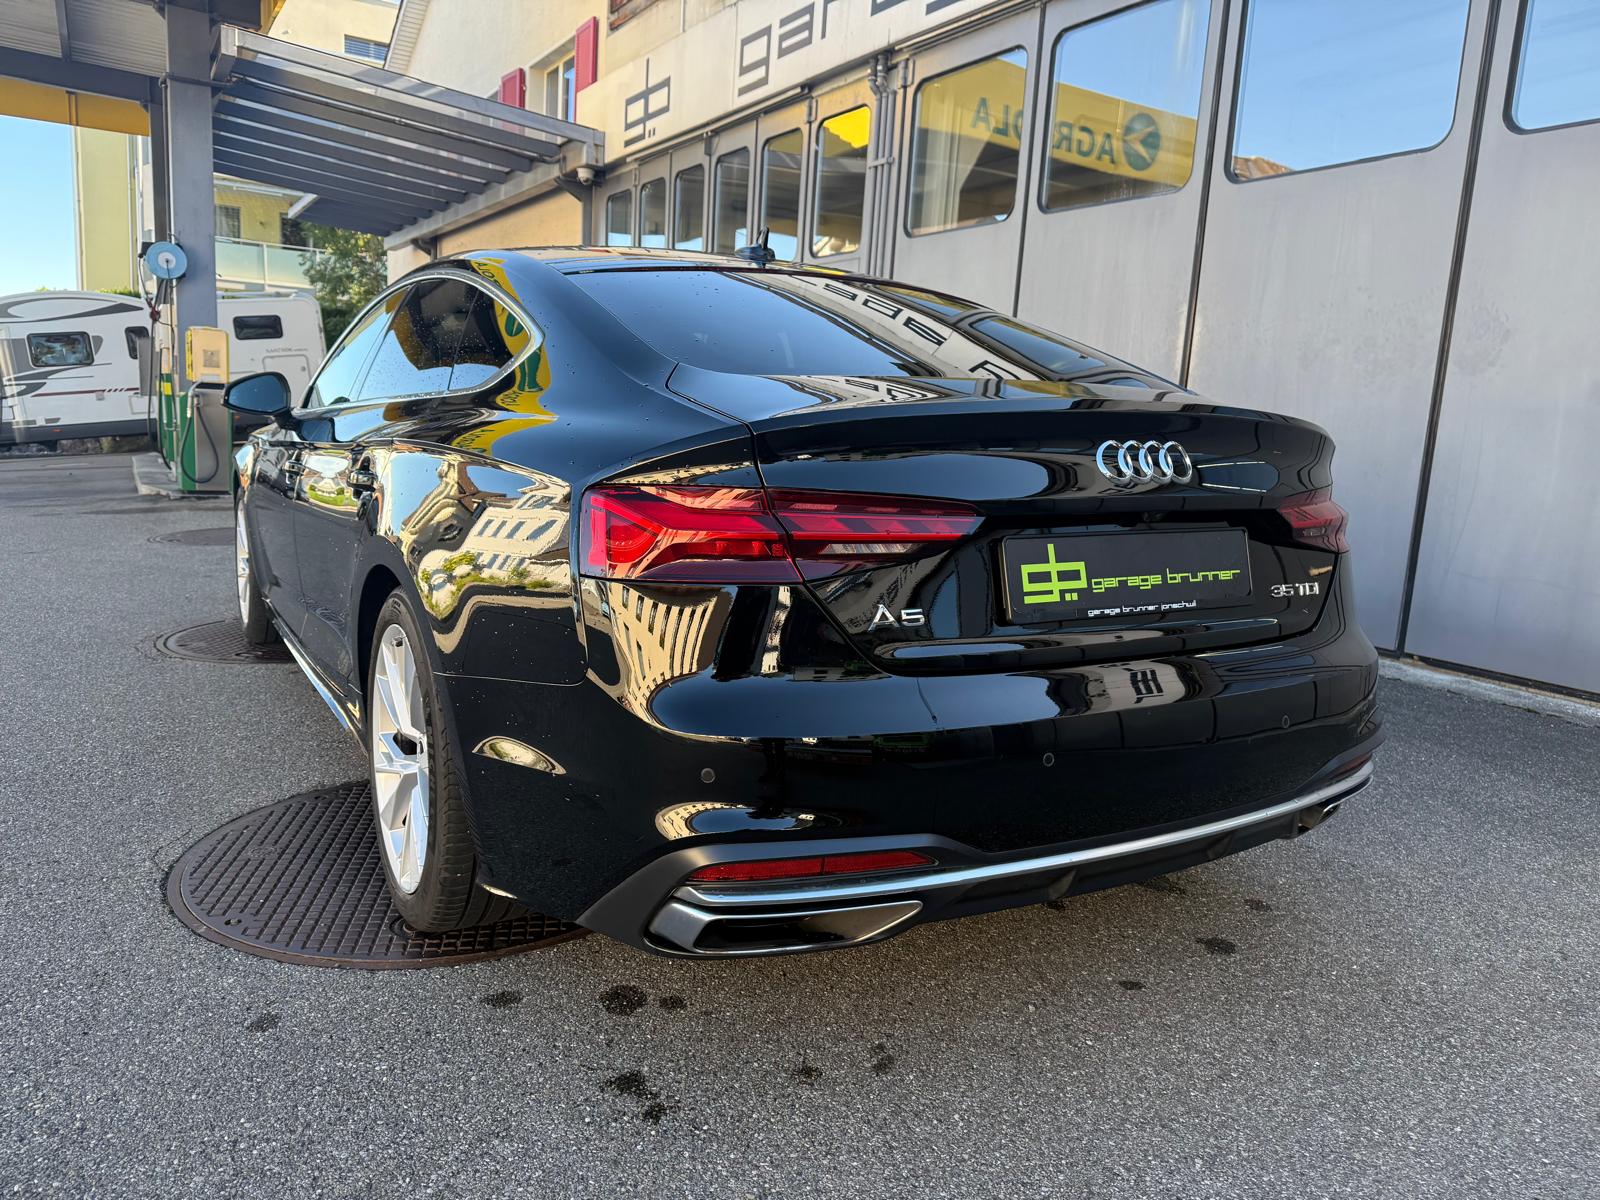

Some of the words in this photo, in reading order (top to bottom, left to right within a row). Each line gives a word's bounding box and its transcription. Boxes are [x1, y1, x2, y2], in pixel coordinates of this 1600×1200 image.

[1092, 575, 1162, 592] garage
[1166, 568, 1240, 583] brunner
[1270, 583, 1294, 597] 35
[1295, 581, 1319, 596] TDI
[867, 604, 925, 631] A5
[1088, 608, 1120, 617] garage
[1122, 605, 1159, 613] brunner
